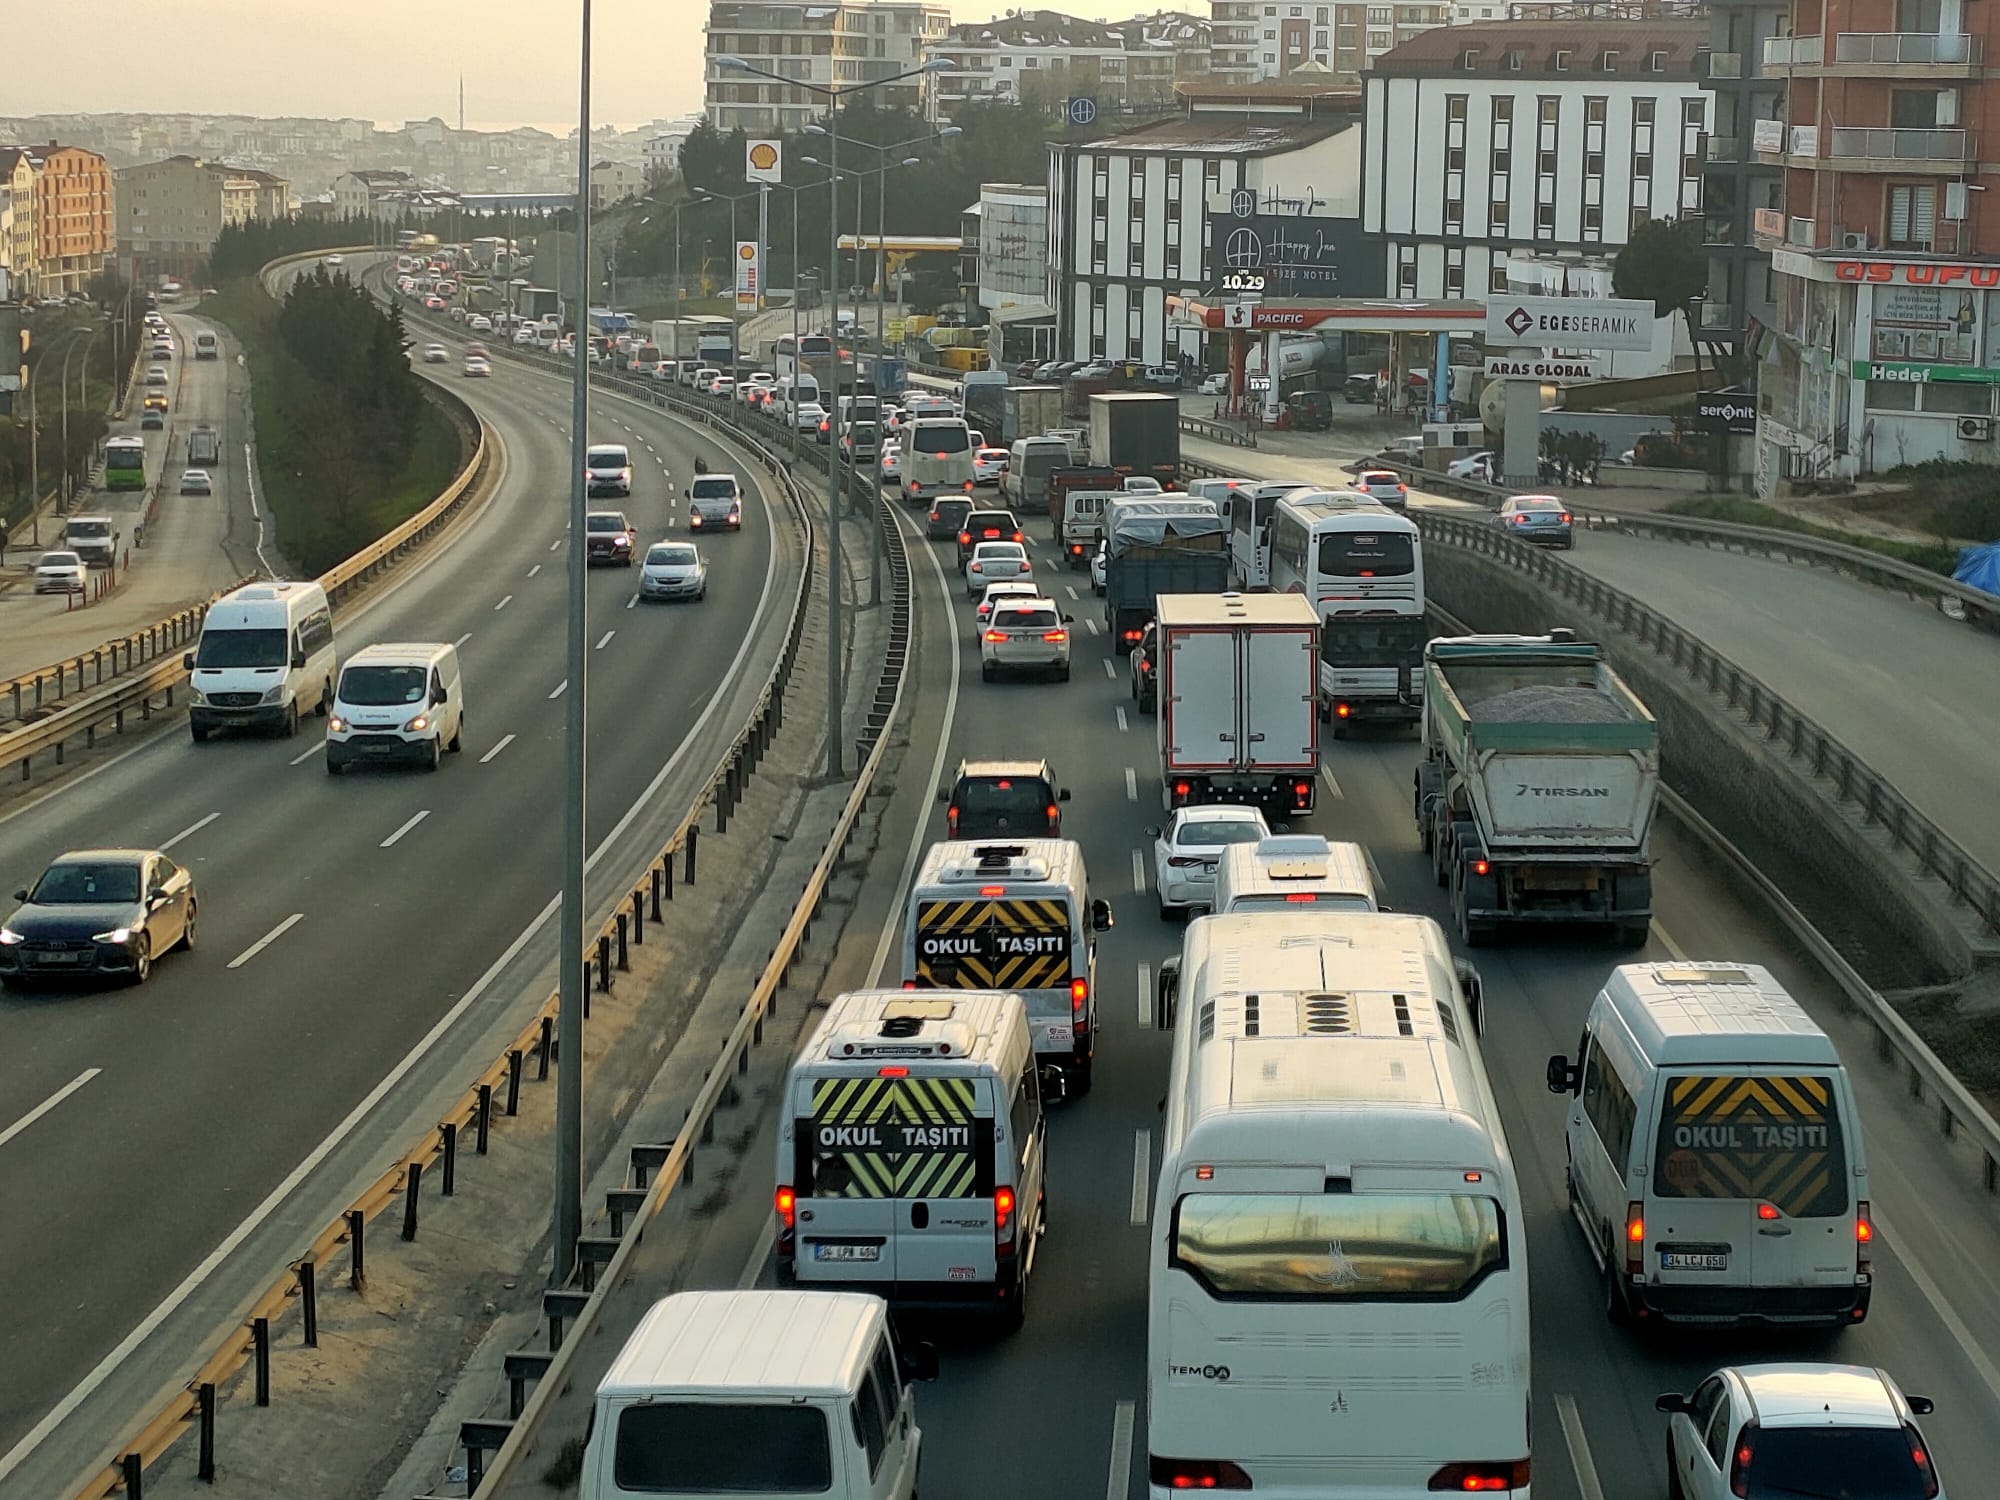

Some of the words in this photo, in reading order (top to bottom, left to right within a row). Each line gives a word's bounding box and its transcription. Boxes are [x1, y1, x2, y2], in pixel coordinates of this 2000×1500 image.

[1266, 226, 1311, 260] Happy
[1316, 229, 1336, 259] Inn
[1222, 275, 1265, 290] 10.29
[1257, 313, 1304, 324] PACIFIC
[1539, 314, 1638, 335] EGESERAMİK
[1490, 362, 1530, 376] ARAS
[1534, 363, 1592, 378] GLOBAL
[1871, 365, 1931, 382] Hedef
[1700, 404, 1755, 420] seranit
[1530, 787, 1609, 797] TIRSAN
[923, 938, 982, 954] OKUL
[996, 936, 1063, 955] TAŞITI
[819, 1127, 882, 1146] OKUL
[901, 1127, 969, 1150] TAŞITI
[1674, 1126, 1742, 1148] OKUL
[1752, 1125, 1828, 1150] TAŞITI
[1668, 1255, 1681, 1266] 34
